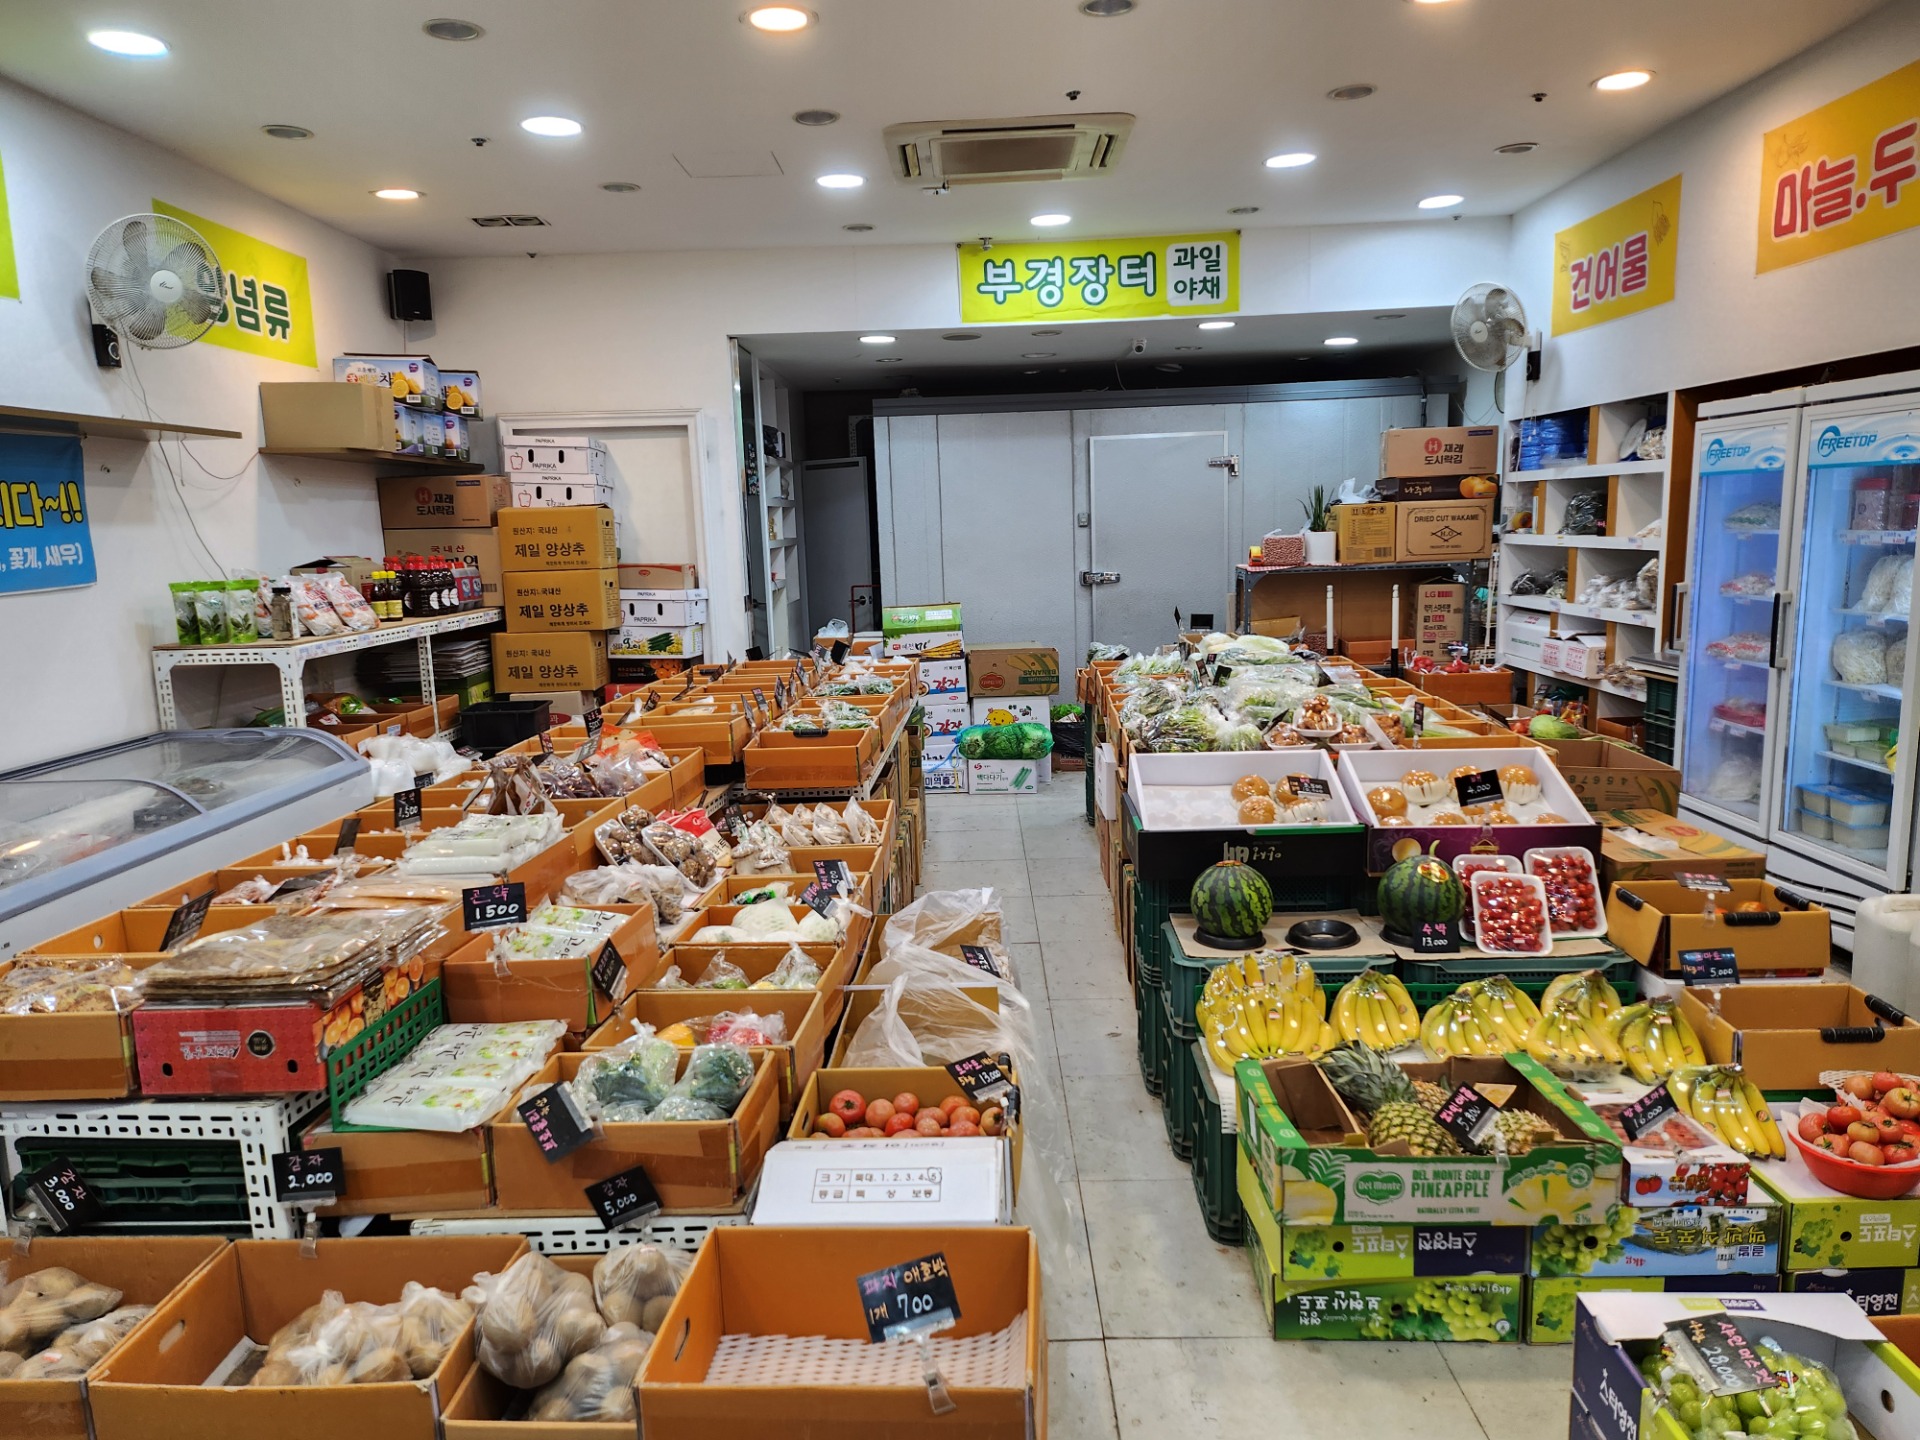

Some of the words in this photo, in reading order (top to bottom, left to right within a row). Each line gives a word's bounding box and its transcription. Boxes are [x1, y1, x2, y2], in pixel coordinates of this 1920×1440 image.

[1173, 244, 1222, 272] 과일
[977, 251, 1157, 308] 부경장터
[1571, 233, 1648, 311] 건어물
[1173, 276, 1221, 301] 야채
[1820, 434, 1878, 451] FREETOP
[1424, 455, 1463, 465] 도시락김
[1708, 446, 1751, 460] FREETOP
[417, 505, 455, 515] 도시락김
[8, 545, 42, 572] 꽃게,
[45, 542, 84, 567] 새우)
[430, 545, 465, 553] 국내산
[515, 543, 540, 557] 제일
[545, 542, 586, 556] 양상추
[519, 605, 545, 618] 제일
[549, 603, 589, 617] 양상추
[508, 665, 533, 679] 제일
[539, 664, 579, 679] 양상추
[933, 677, 960, 692] 감자
[936, 719, 963, 735] 감자
[469, 885, 510, 904] 곤약
[475, 902, 520, 920] 1500
[1422, 922, 1448, 936] 수박
[955, 1059, 981, 1076] 토마토
[1439, 1086, 1479, 1124] 파인애플
[288, 1153, 323, 1171] 감자
[288, 1172, 333, 1189] 2,000
[1411, 1170, 1430, 1181] DEL
[1432, 1170, 1462, 1181] MONTE
[1465, 1170, 1491, 1181] GOLD
[44, 1175, 75, 1211] 3,000
[61, 1168, 86, 1201] 감자
[1356, 1179, 1377, 1191] Del
[1378, 1179, 1402, 1191] Monte
[1410, 1182, 1490, 1198] PINEAPPLE
[604, 1193, 637, 1216] 5,000
[1418, 1231, 1477, 1251] 스타영천
[1858, 1224, 1917, 1242] 스타포도
[1352, 1233, 1409, 1254] 스타포도
[903, 1257, 949, 1284] 애호박
[1491, 1284, 1513, 1295] 4kg
[869, 1302, 889, 1324] 1개
[896, 1293, 933, 1318] 700
[1297, 1294, 1329, 1310] 포도
[1331, 1290, 1380, 1310] 보현산
[1855, 1293, 1899, 1311] 타영천
[1298, 1311, 1321, 1325] 영천
